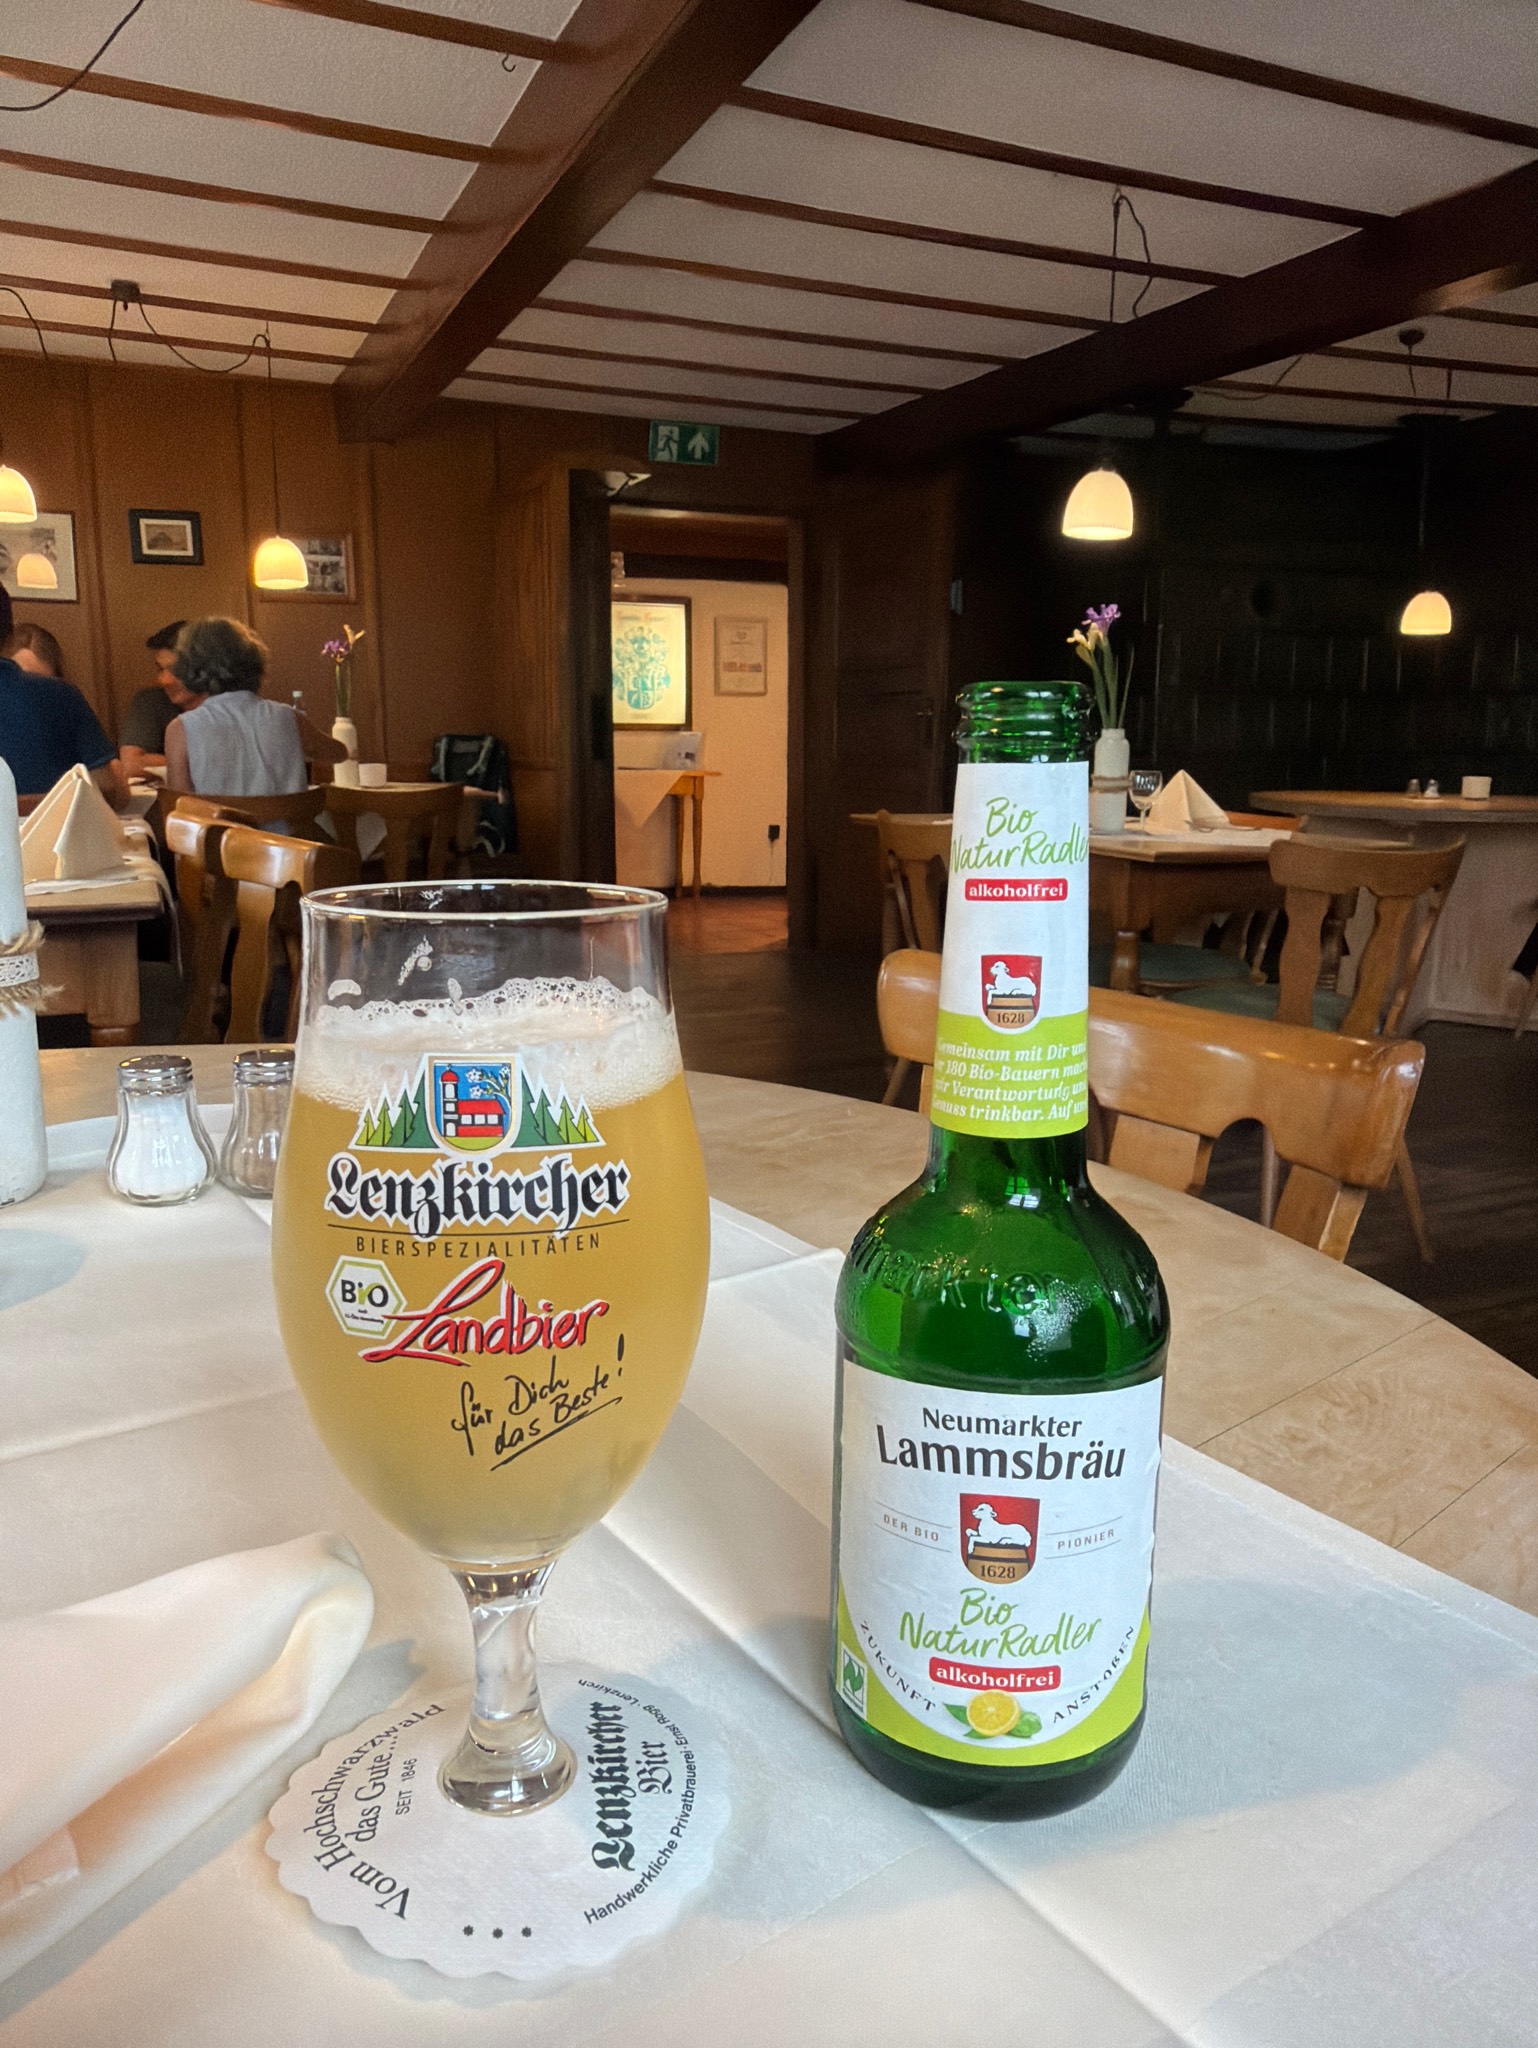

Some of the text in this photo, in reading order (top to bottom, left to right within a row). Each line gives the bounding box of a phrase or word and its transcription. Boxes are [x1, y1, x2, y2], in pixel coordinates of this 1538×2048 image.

[986, 797, 1039, 838] Bio
[969, 883, 1064, 897] alkoholfrei
[996, 1013, 1025, 1024] 1628
[946, 1060, 967, 1077] 180
[969, 1064, 1059, 1081] Bio-Bauern
[1014, 1045, 1042, 1062] mit
[1046, 1044, 1069, 1060] Dir
[952, 1080, 1069, 1101] Verantwortung
[970, 1103, 1044, 1122] trinkbar.
[1048, 1099, 1073, 1120] Auf
[326, 1154, 630, 1239] Lenzkircher
[356, 1233, 600, 1258] BIERSPEZIALITÄTEN
[361, 1256, 609, 1366] Landbier
[451, 1355, 569, 1456] für Dich
[922, 1407, 1082, 1437] Neumarkter
[495, 1418, 541, 1455] das
[876, 1424, 1126, 1480] Lammsbräu
[883, 1513, 940, 1542] DER BIO
[1057, 1528, 1116, 1550] PIONIER
[980, 1565, 1016, 1580] 1628
[959, 1587, 1019, 1626] Bio
[899, 1611, 1102, 1658] NaturRadler
[860, 1620, 936, 1711] ZUKUNFT
[935, 1664, 1055, 1688] alkoholfrei
[586, 1701, 636, 1871] Lenzkircher
[636, 1741, 672, 1794] Bier
[395, 1758, 418, 1815] SEIT 1846
[578, 1679, 697, 1924] Handwerkliche Privatbrauerei Ernst Rogg Lenzkirch
[303, 1704, 446, 1920] Vom Hochschwarzwald
[345, 1805, 382, 1842] das
